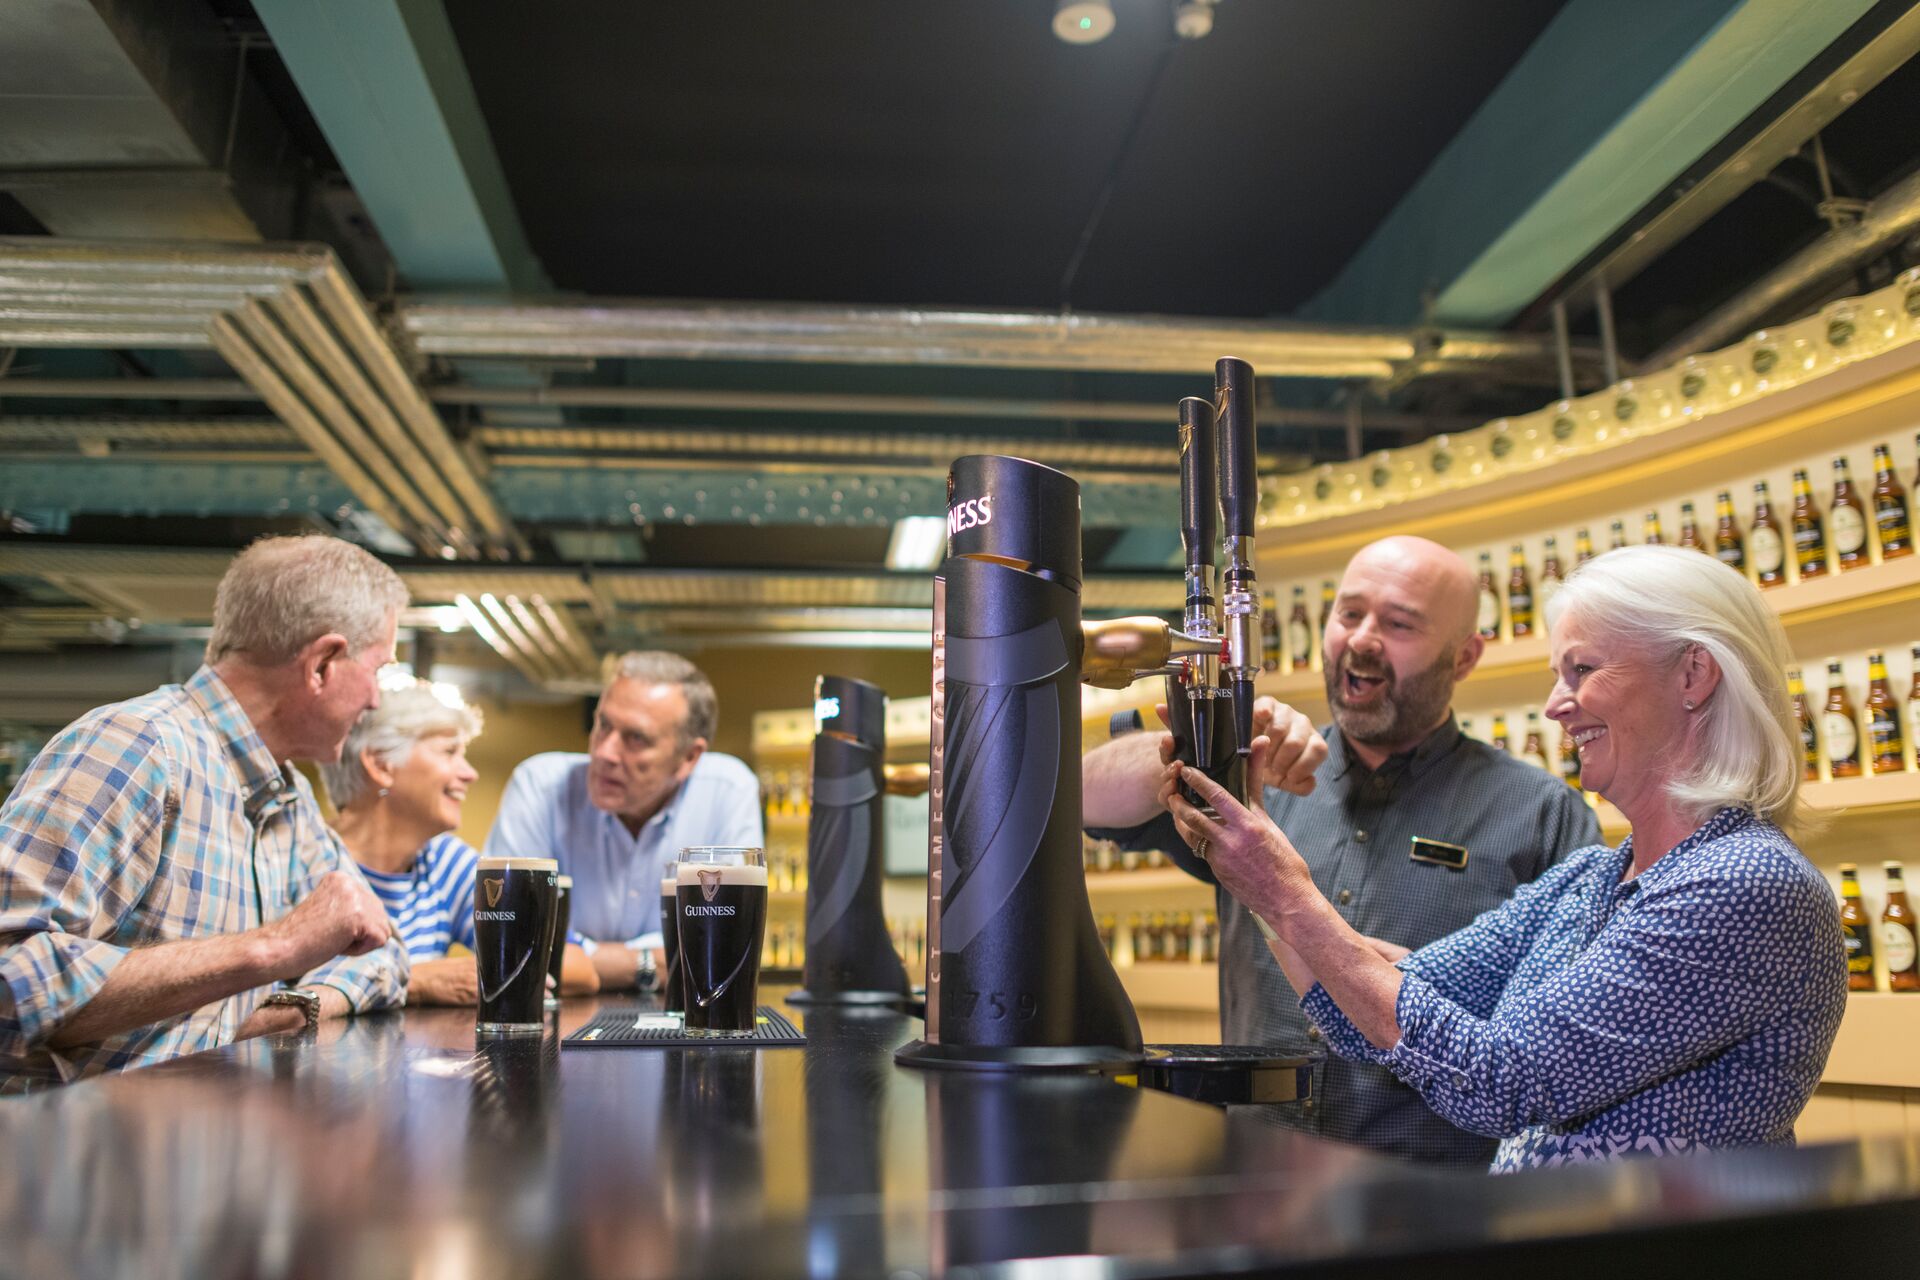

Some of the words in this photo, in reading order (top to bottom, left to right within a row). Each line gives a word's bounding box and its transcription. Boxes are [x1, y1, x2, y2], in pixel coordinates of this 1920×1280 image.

[947, 495, 992, 538] NESS
[474, 910, 516, 921] GUINNESS
[684, 904, 736, 917] GUINNESS
[947, 991, 1038, 1021] 1759
